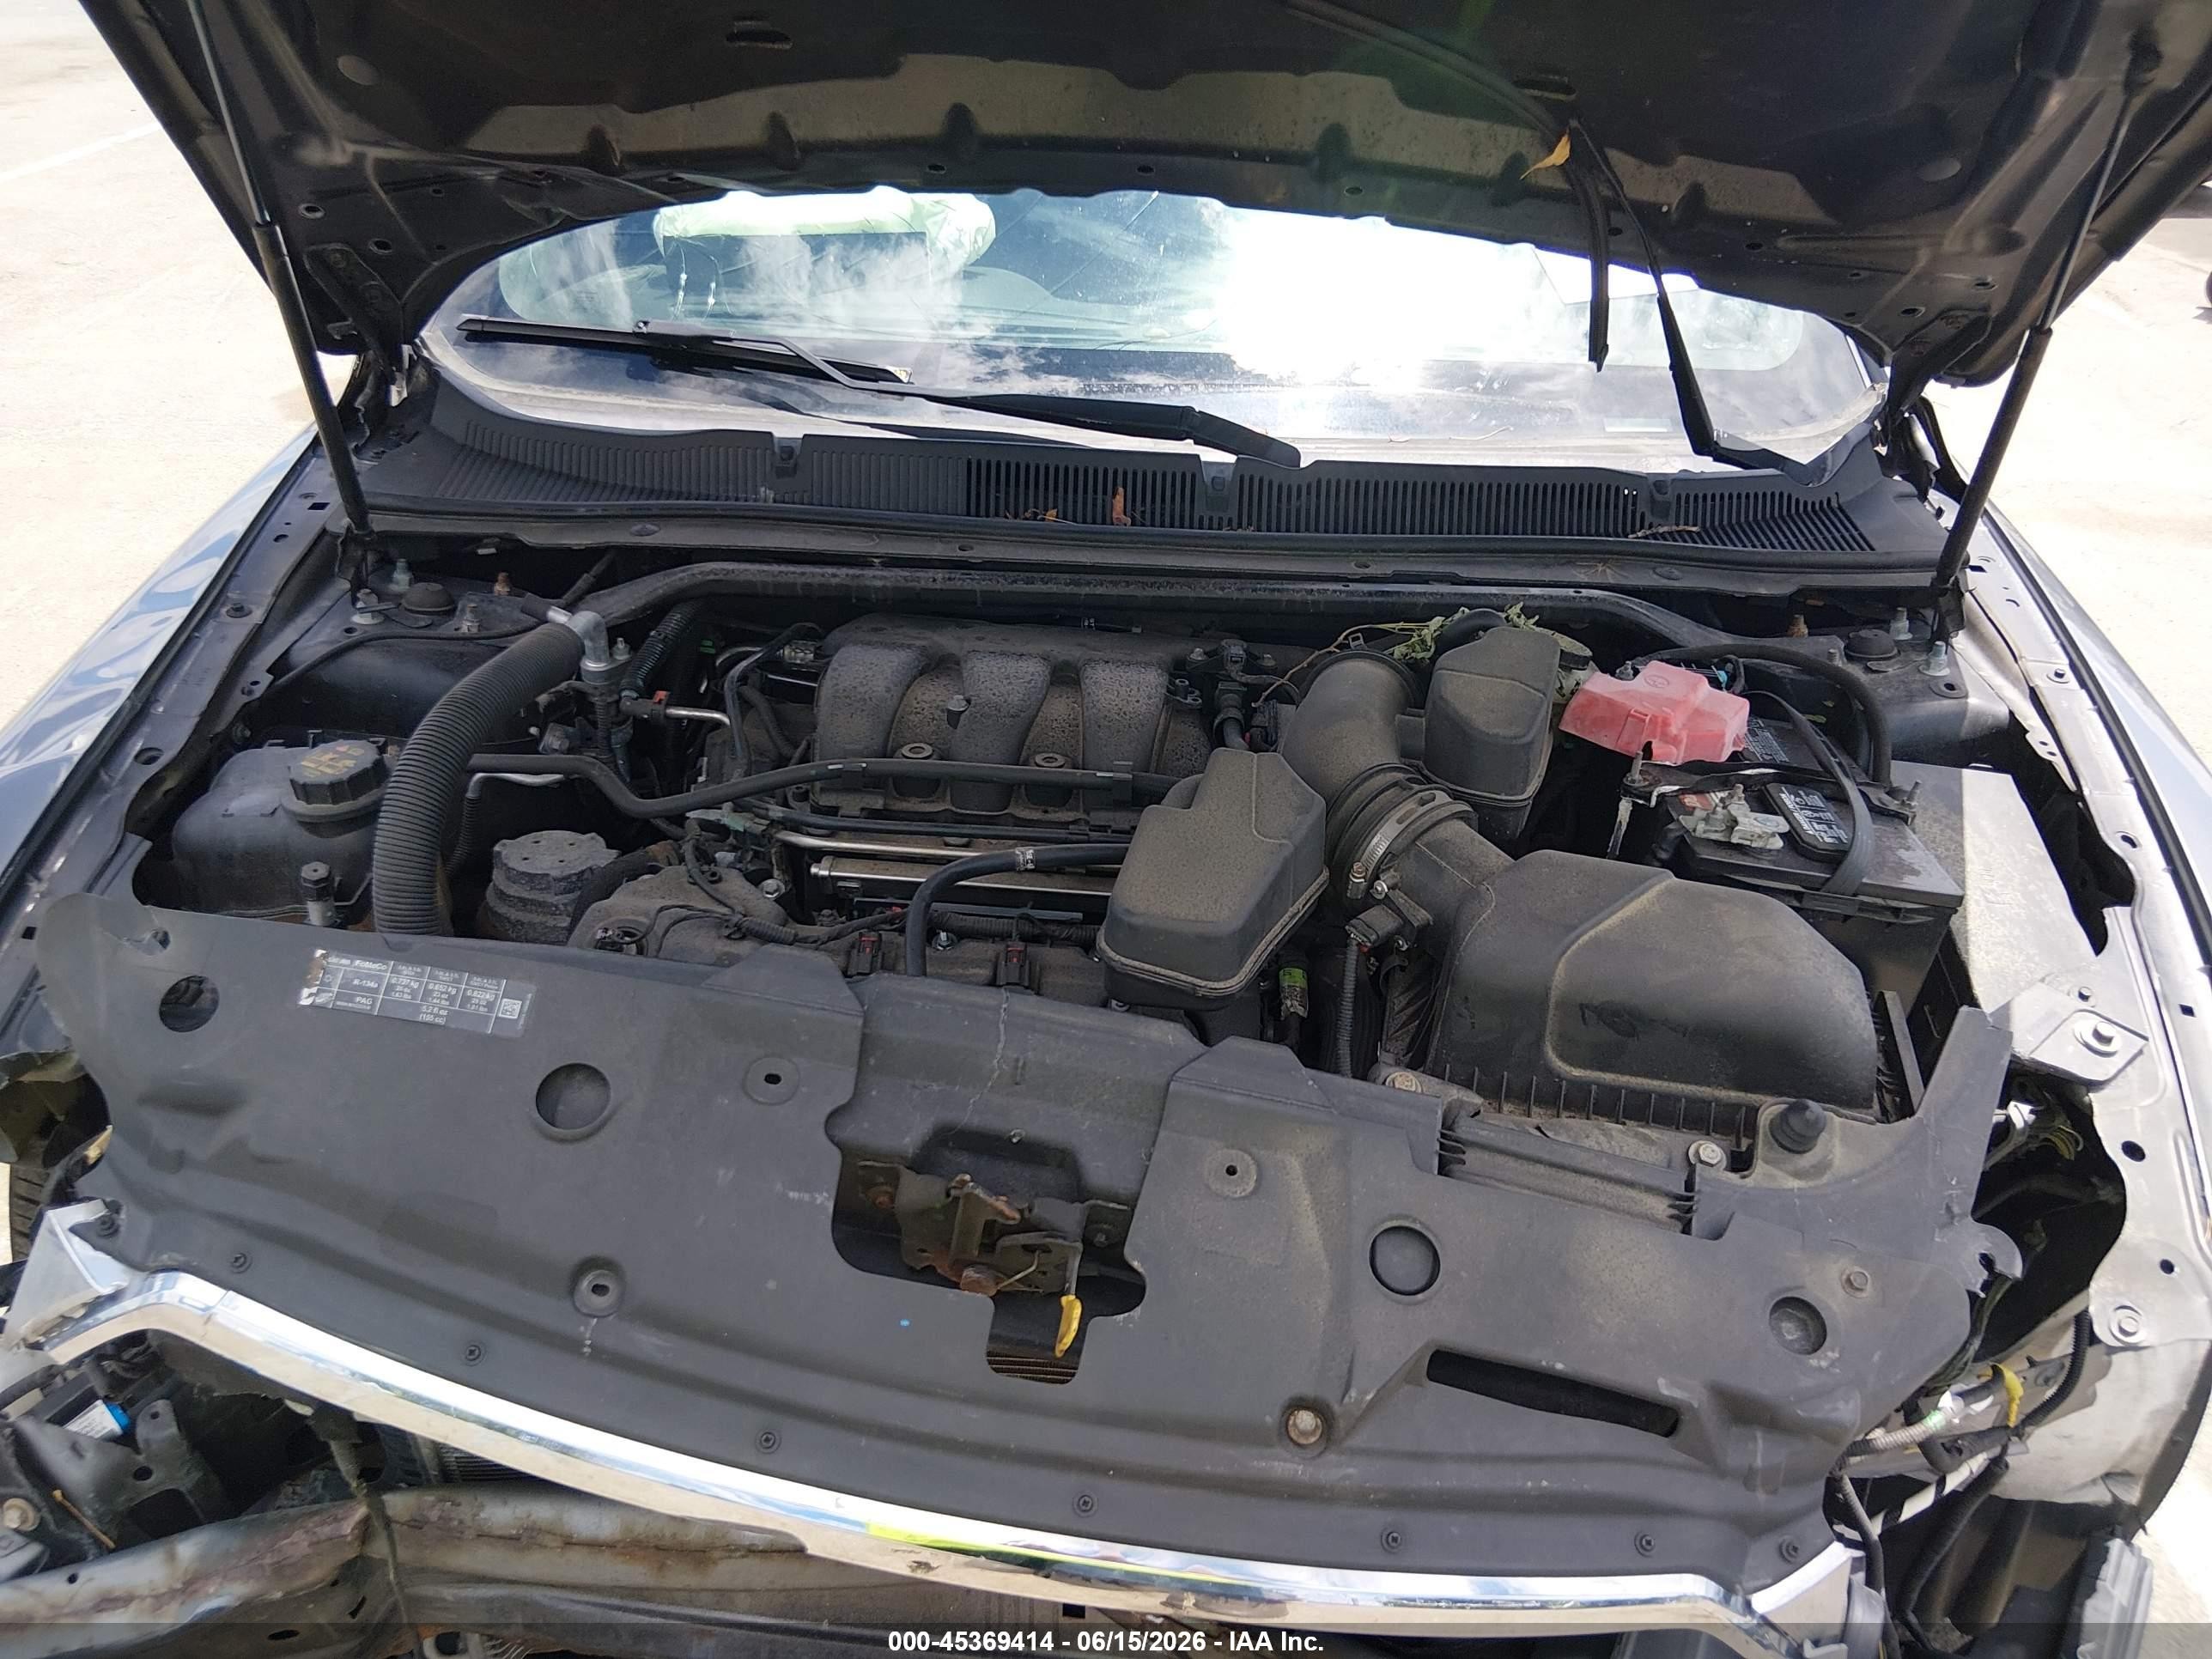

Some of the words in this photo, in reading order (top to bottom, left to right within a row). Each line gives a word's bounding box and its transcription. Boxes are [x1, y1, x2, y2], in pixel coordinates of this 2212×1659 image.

[355, 959, 387, 970] FoMoCo
[410, 979, 419, 989] kg
[447, 986, 457, 995] kg
[356, 996, 373, 1005] PAG
[486, 992, 495, 1001] kg
